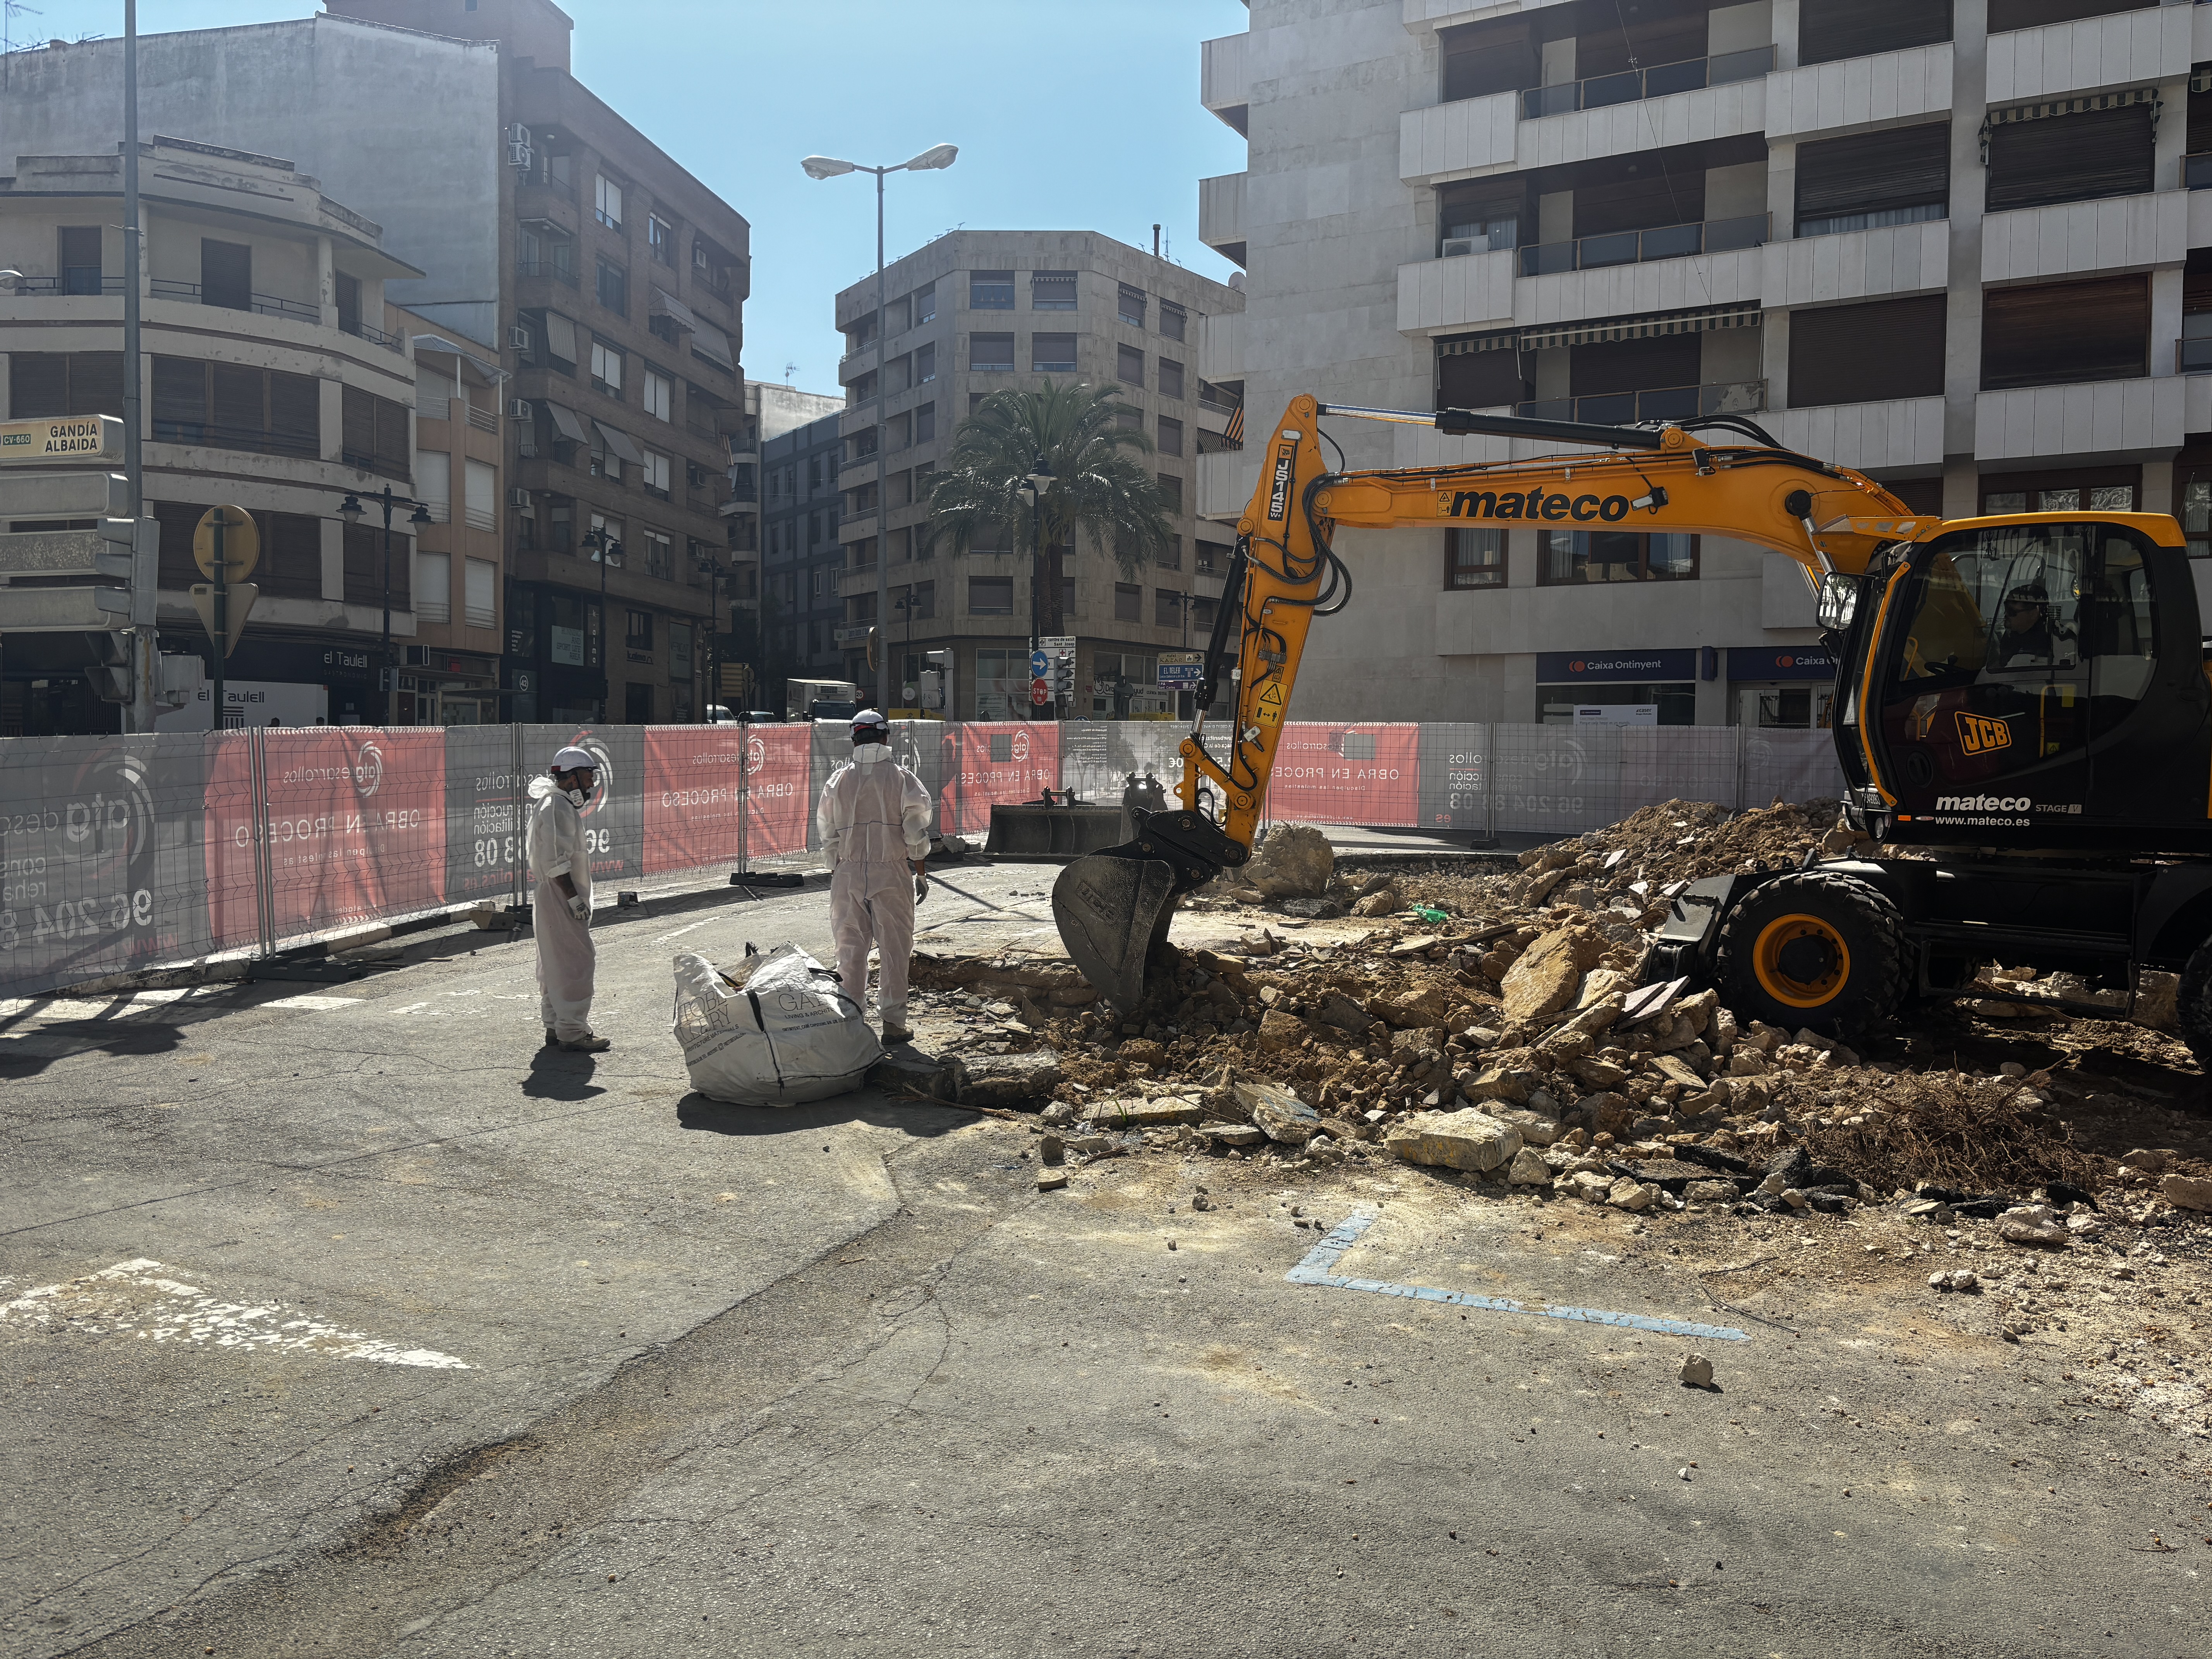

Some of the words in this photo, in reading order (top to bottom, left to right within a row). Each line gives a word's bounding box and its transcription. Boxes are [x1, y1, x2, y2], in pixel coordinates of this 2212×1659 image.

[50, 421, 97, 438] GANDÍA
[4, 435, 30, 444] CV-660
[45, 438, 97, 452] ALBAIDA
[1271, 460, 1289, 513] JS145
[1451, 486, 1629, 522] mateco
[337, 652, 367, 668] Taulell
[1587, 661, 1613, 670] Caixa
[1615, 660, 1661, 670] Ontinyent
[1796, 656, 1825, 665] Caixa
[223, 690, 264, 703] aulell
[1964, 717, 2008, 751] JCB
[1936, 793, 2031, 811] mateco
[1935, 816, 2030, 826] www.mateco.es
